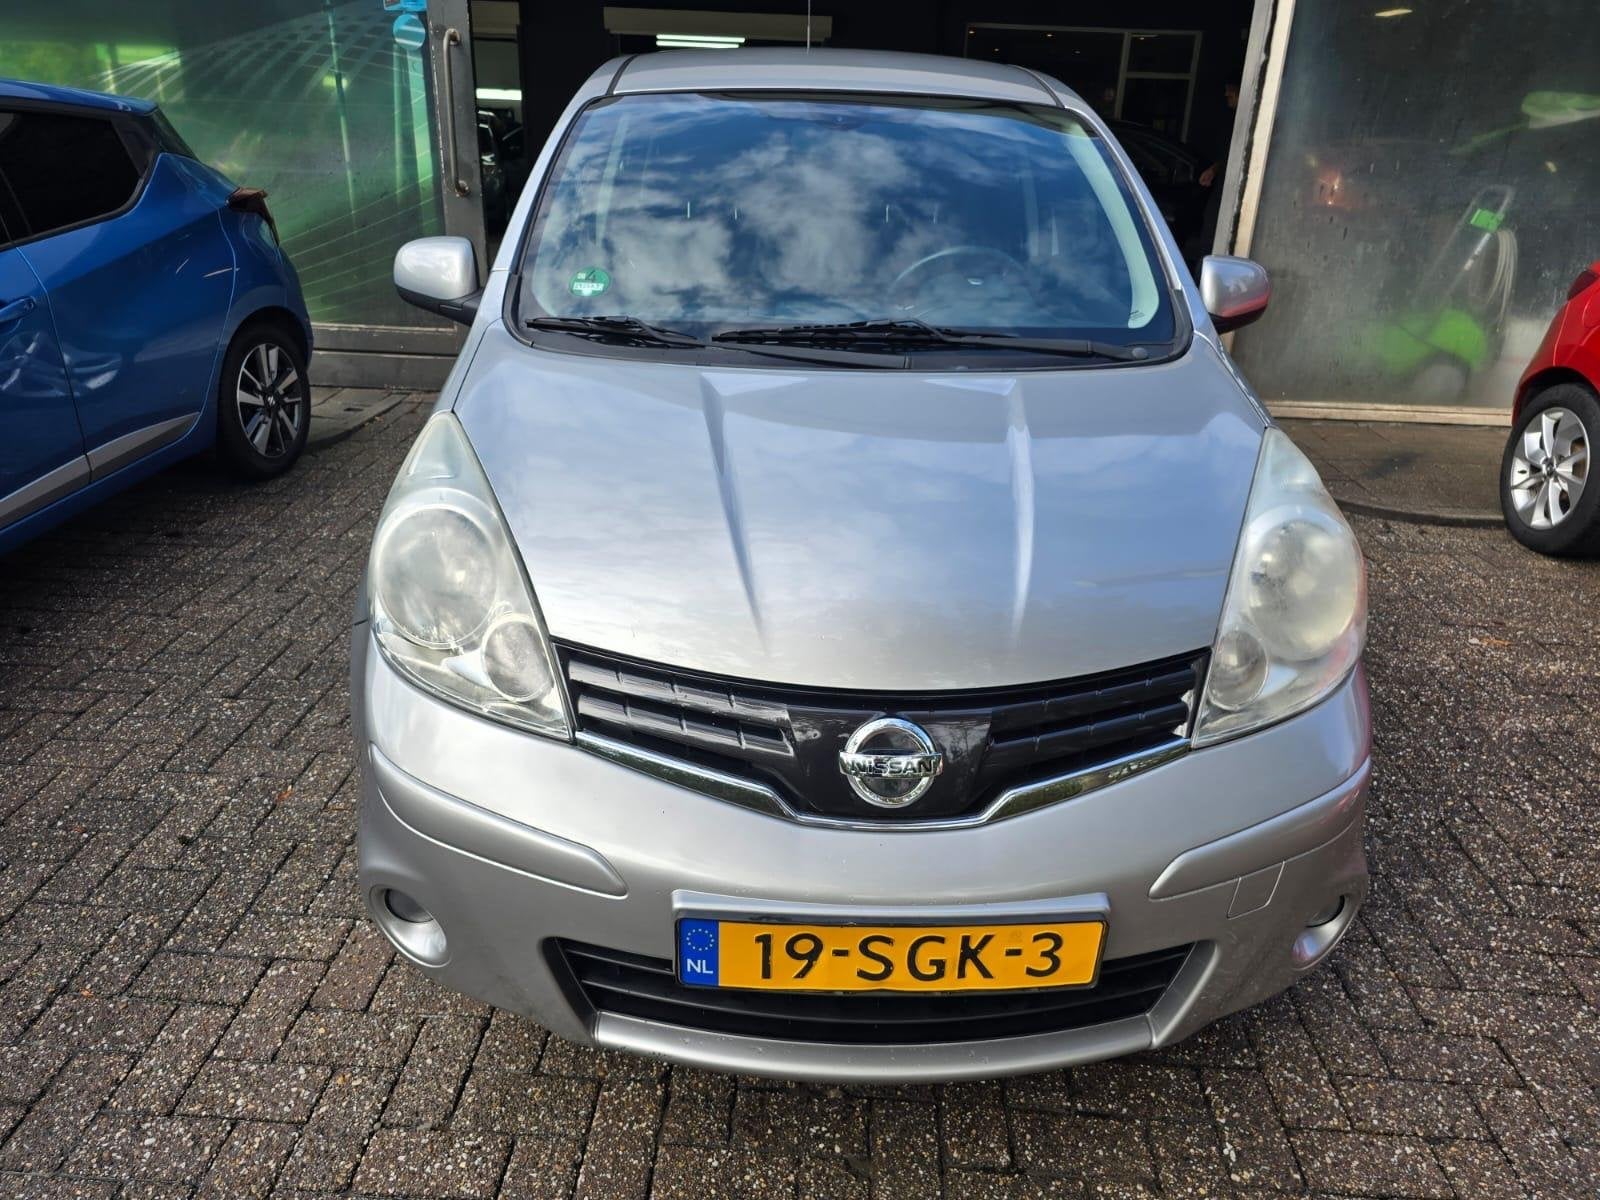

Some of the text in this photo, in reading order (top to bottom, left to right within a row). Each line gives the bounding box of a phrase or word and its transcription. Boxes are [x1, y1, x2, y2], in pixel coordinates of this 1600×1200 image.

[850, 758, 933, 775] NISSAN
[754, 931, 1064, 982] 19-SGK-3
[687, 958, 714, 974] NL
